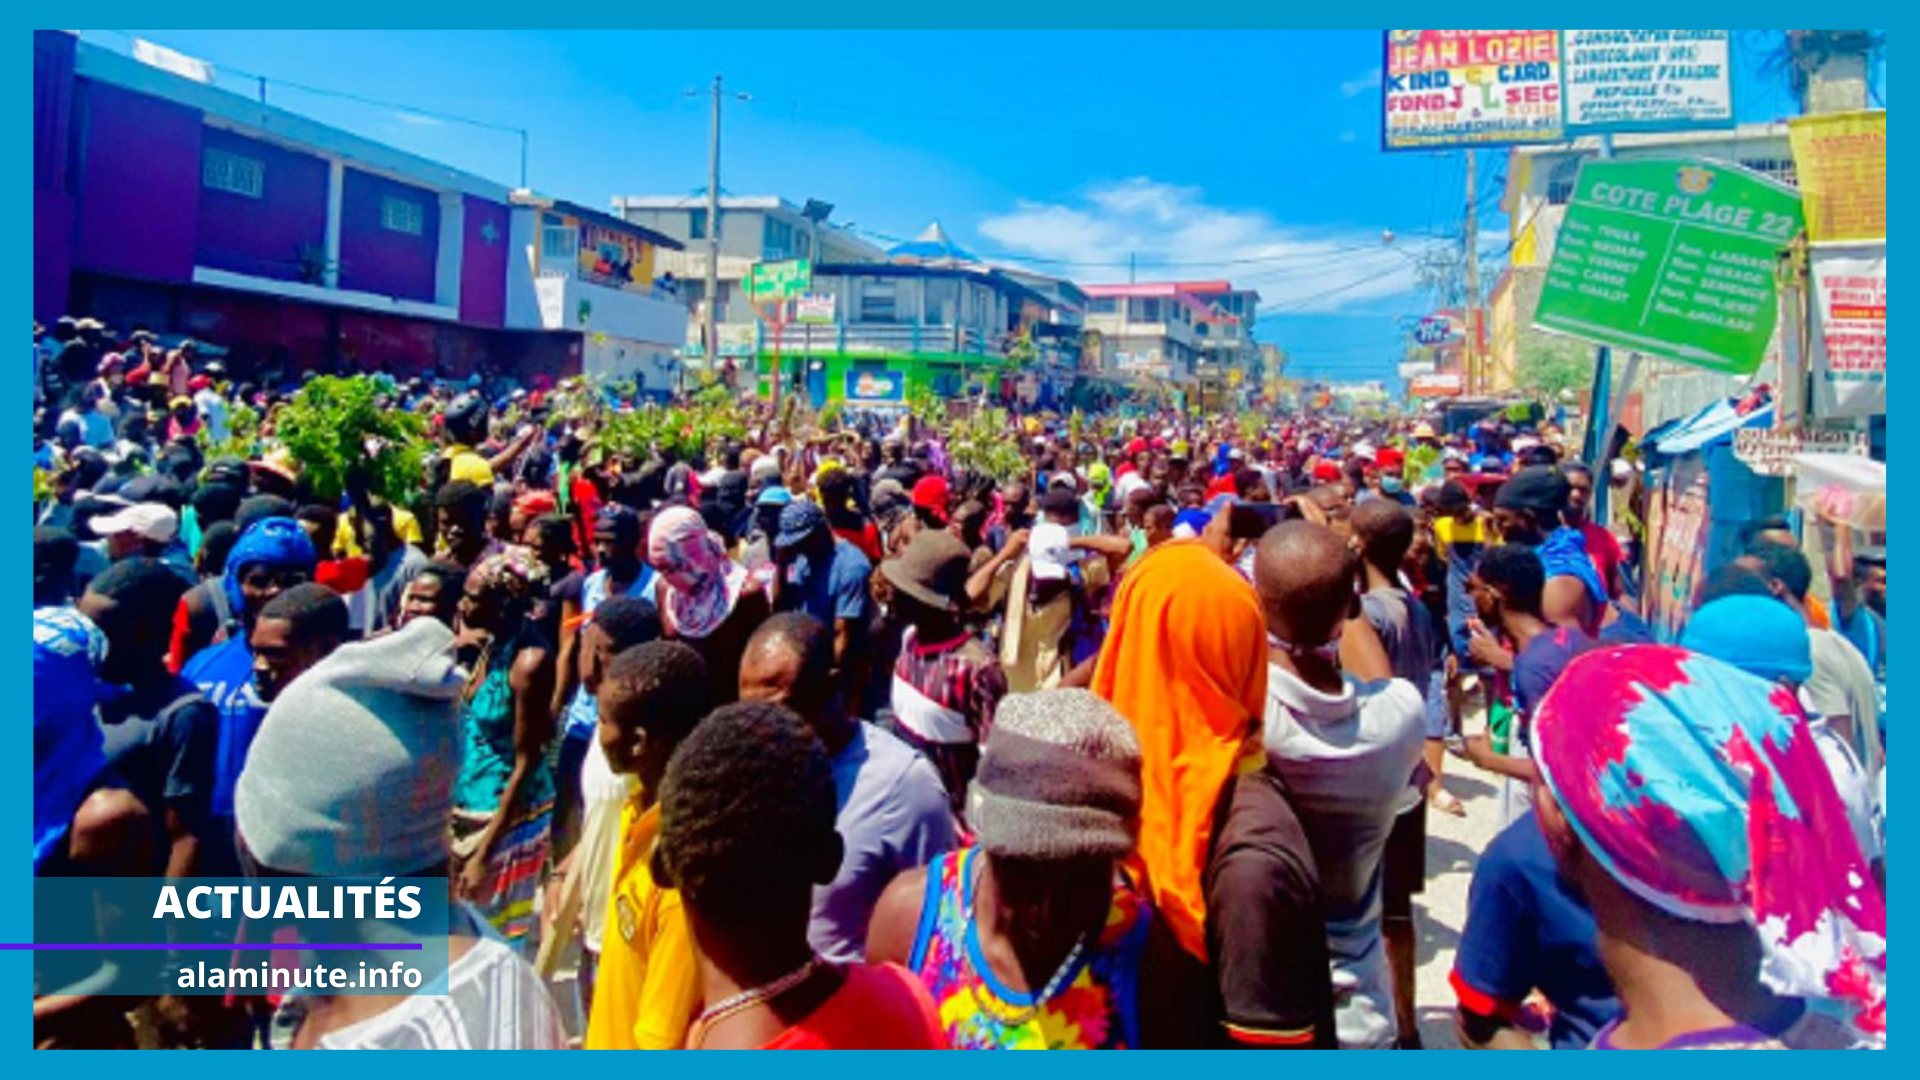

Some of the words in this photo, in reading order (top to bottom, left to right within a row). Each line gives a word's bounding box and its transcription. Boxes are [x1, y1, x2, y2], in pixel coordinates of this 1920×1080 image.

[1390, 38, 1459, 69] JEAN
[1387, 69, 1450, 91] KIND
[1591, 182, 1659, 211] COTE
[1662, 194, 1752, 229] PLAGE
[1758, 212, 1794, 237] 22
